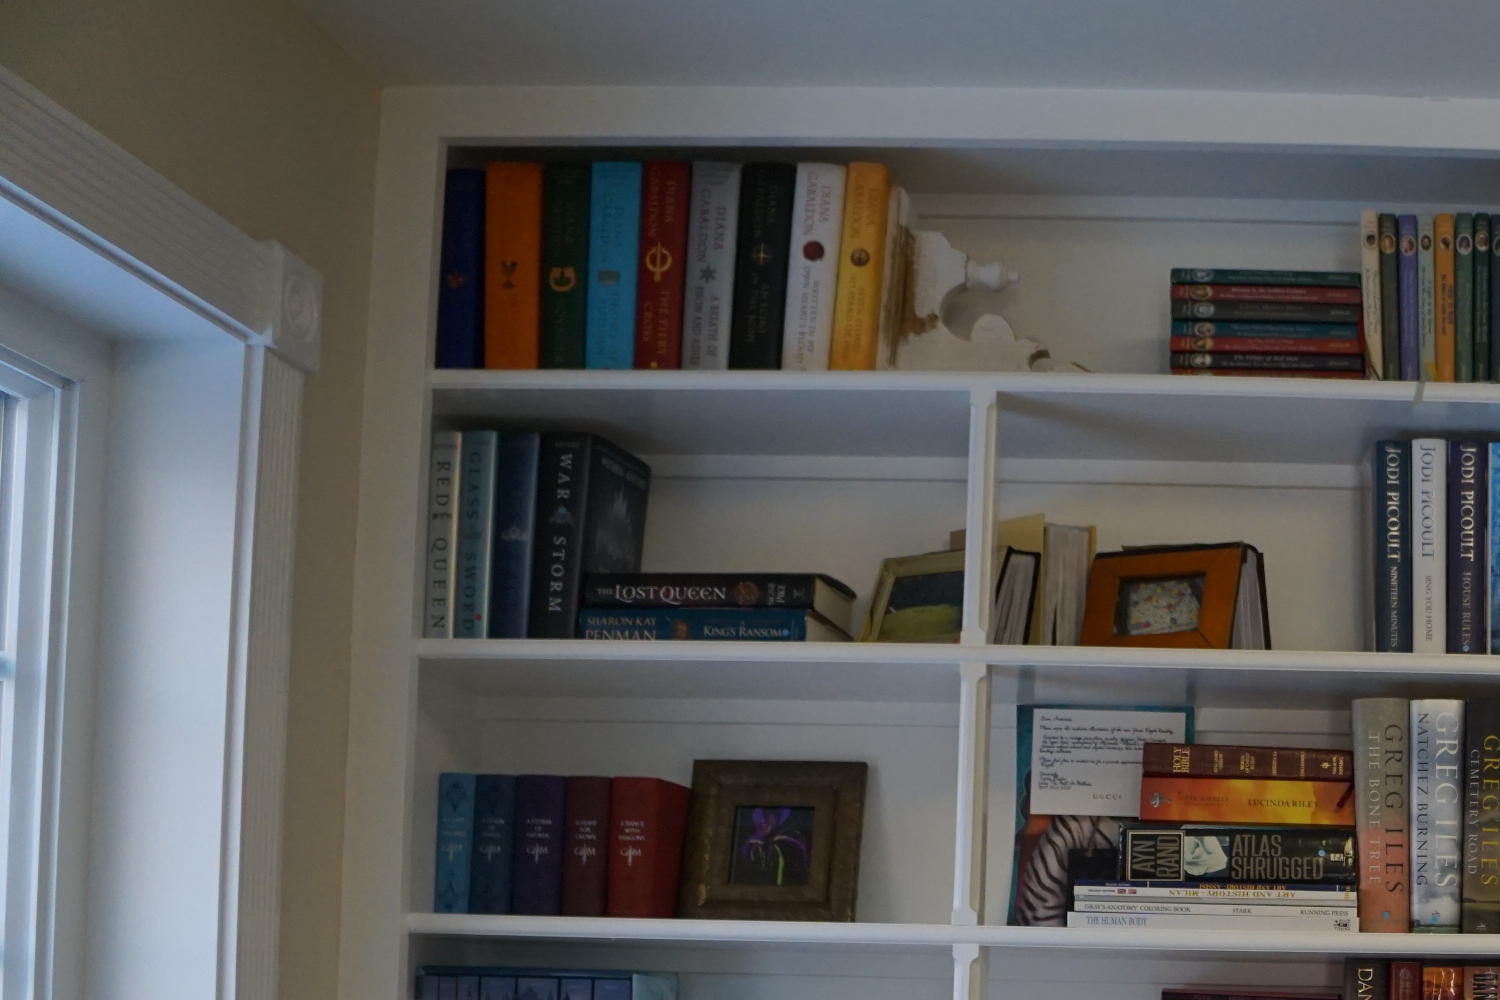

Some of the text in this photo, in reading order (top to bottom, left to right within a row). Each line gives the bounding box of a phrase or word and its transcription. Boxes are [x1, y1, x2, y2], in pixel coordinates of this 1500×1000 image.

[713, 206, 727, 250] DIANA
[803, 170, 818, 236] GABALDON
[819, 185, 832, 223] DIANA
[1420, 445, 1436, 482] JODI
[548, 453, 573, 613] WAR STORM
[1385, 446, 1401, 563] JODI PICOULT
[1420, 489, 1435, 561] PICOULT
[432, 461, 451, 629] RED QUEEN
[462, 452, 481, 631] GLASS SWORD
[1460, 446, 1476, 646] JODI PICOULT HOUSE RULES
[586, 616, 656, 626] SHARON KAY
[613, 584, 727, 605] LOST QUEEN
[703, 620, 782, 637] KING'S RANSOM
[1172, 747, 1181, 773] HOLY
[1367, 733, 1380, 883] THE BONE TREE
[1384, 724, 1404, 894] GREG ILES
[1416, 713, 1429, 886] NATCHEZ BURNING
[1434, 711, 1458, 887] GREG ILES
[1467, 749, 1480, 875] CEMETERY ROAD
[1480, 735, 1500, 886] GREG ILES
[1134, 838, 1155, 875] AYN
[1156, 835, 1179, 879] RAND
[1233, 834, 1281, 856] ATLAS
[1233, 857, 1324, 881] SHRUGGED
[1472, 973, 1498, 1000] DAN
